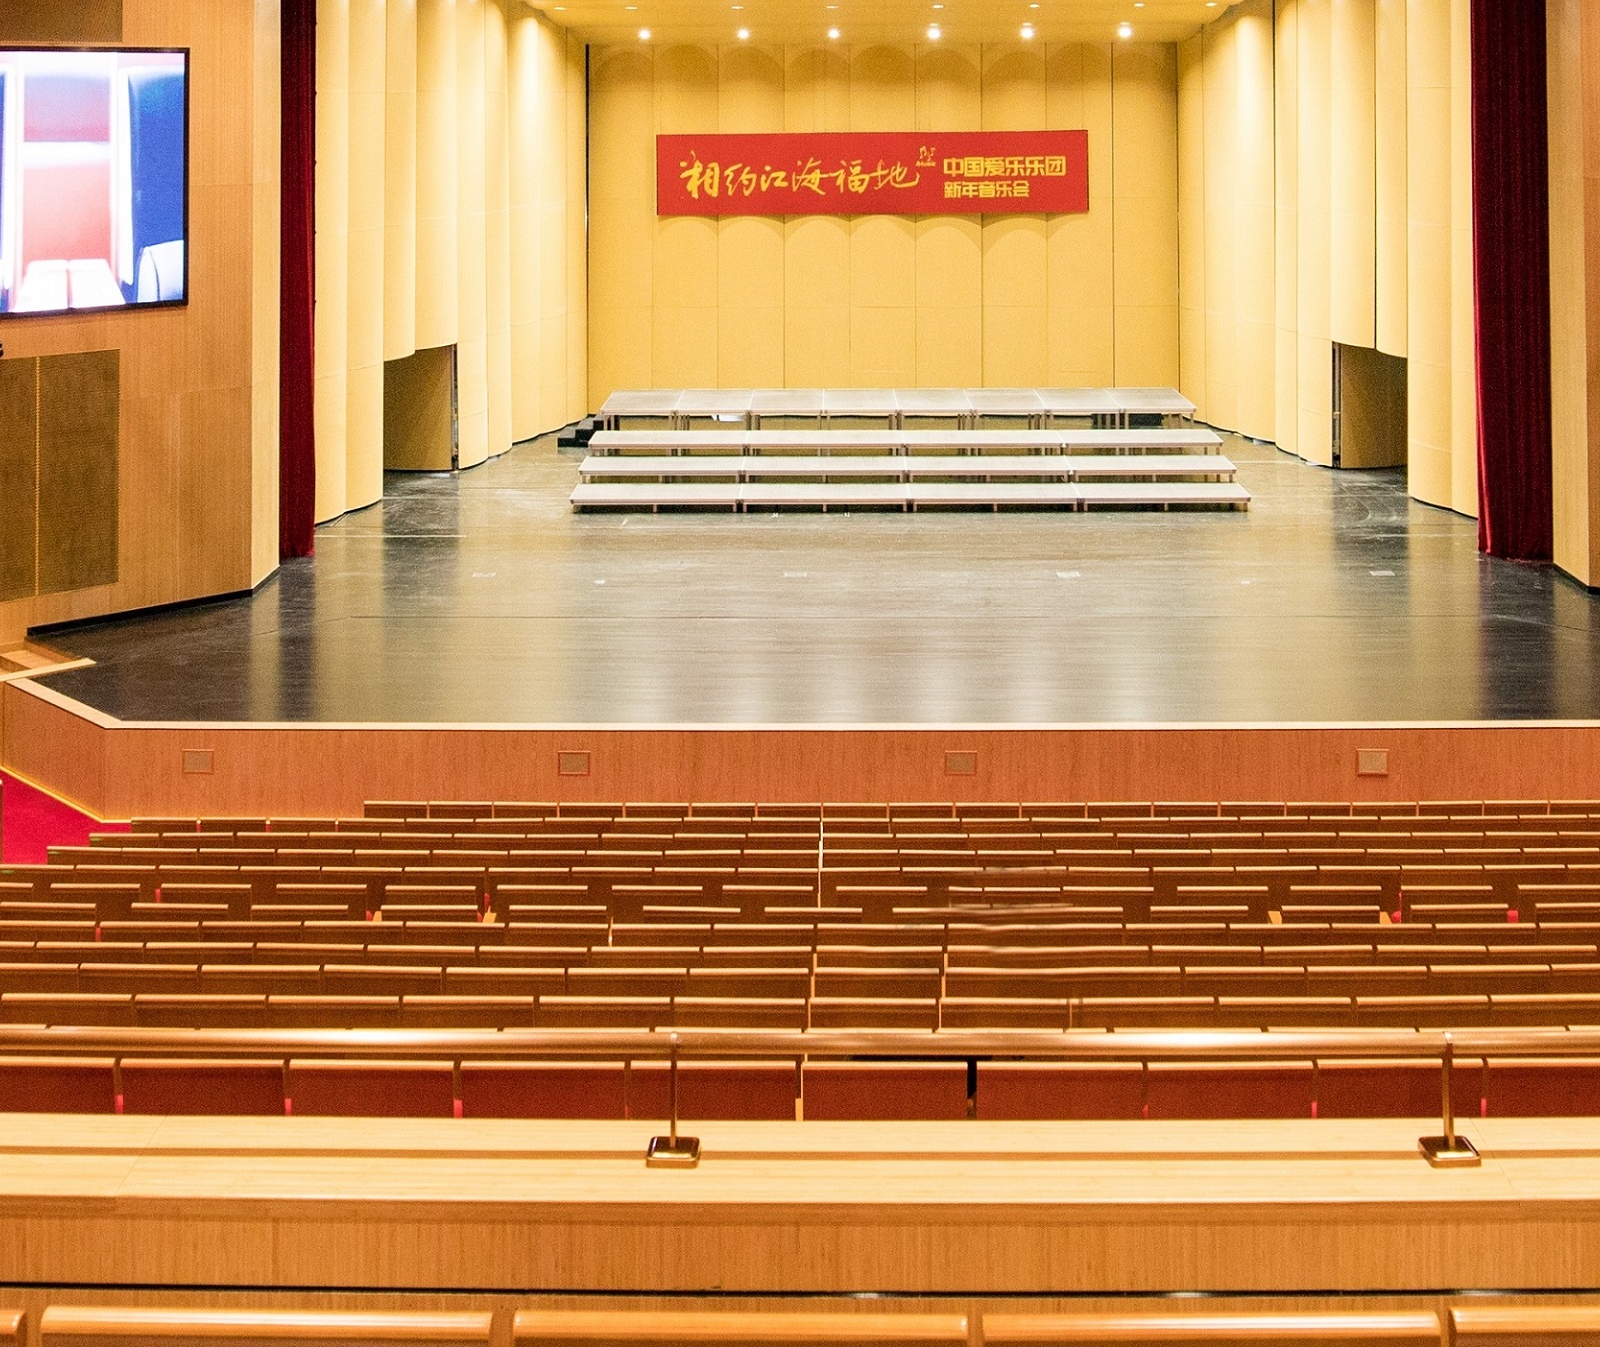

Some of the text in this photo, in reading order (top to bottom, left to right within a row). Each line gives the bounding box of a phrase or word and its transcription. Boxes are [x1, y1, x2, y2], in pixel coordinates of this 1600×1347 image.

[680, 150, 920, 199] 相约江海福地
[943, 155, 1066, 177] 中国爱乐乐团
[944, 180, 1030, 199] 新年音乐会
